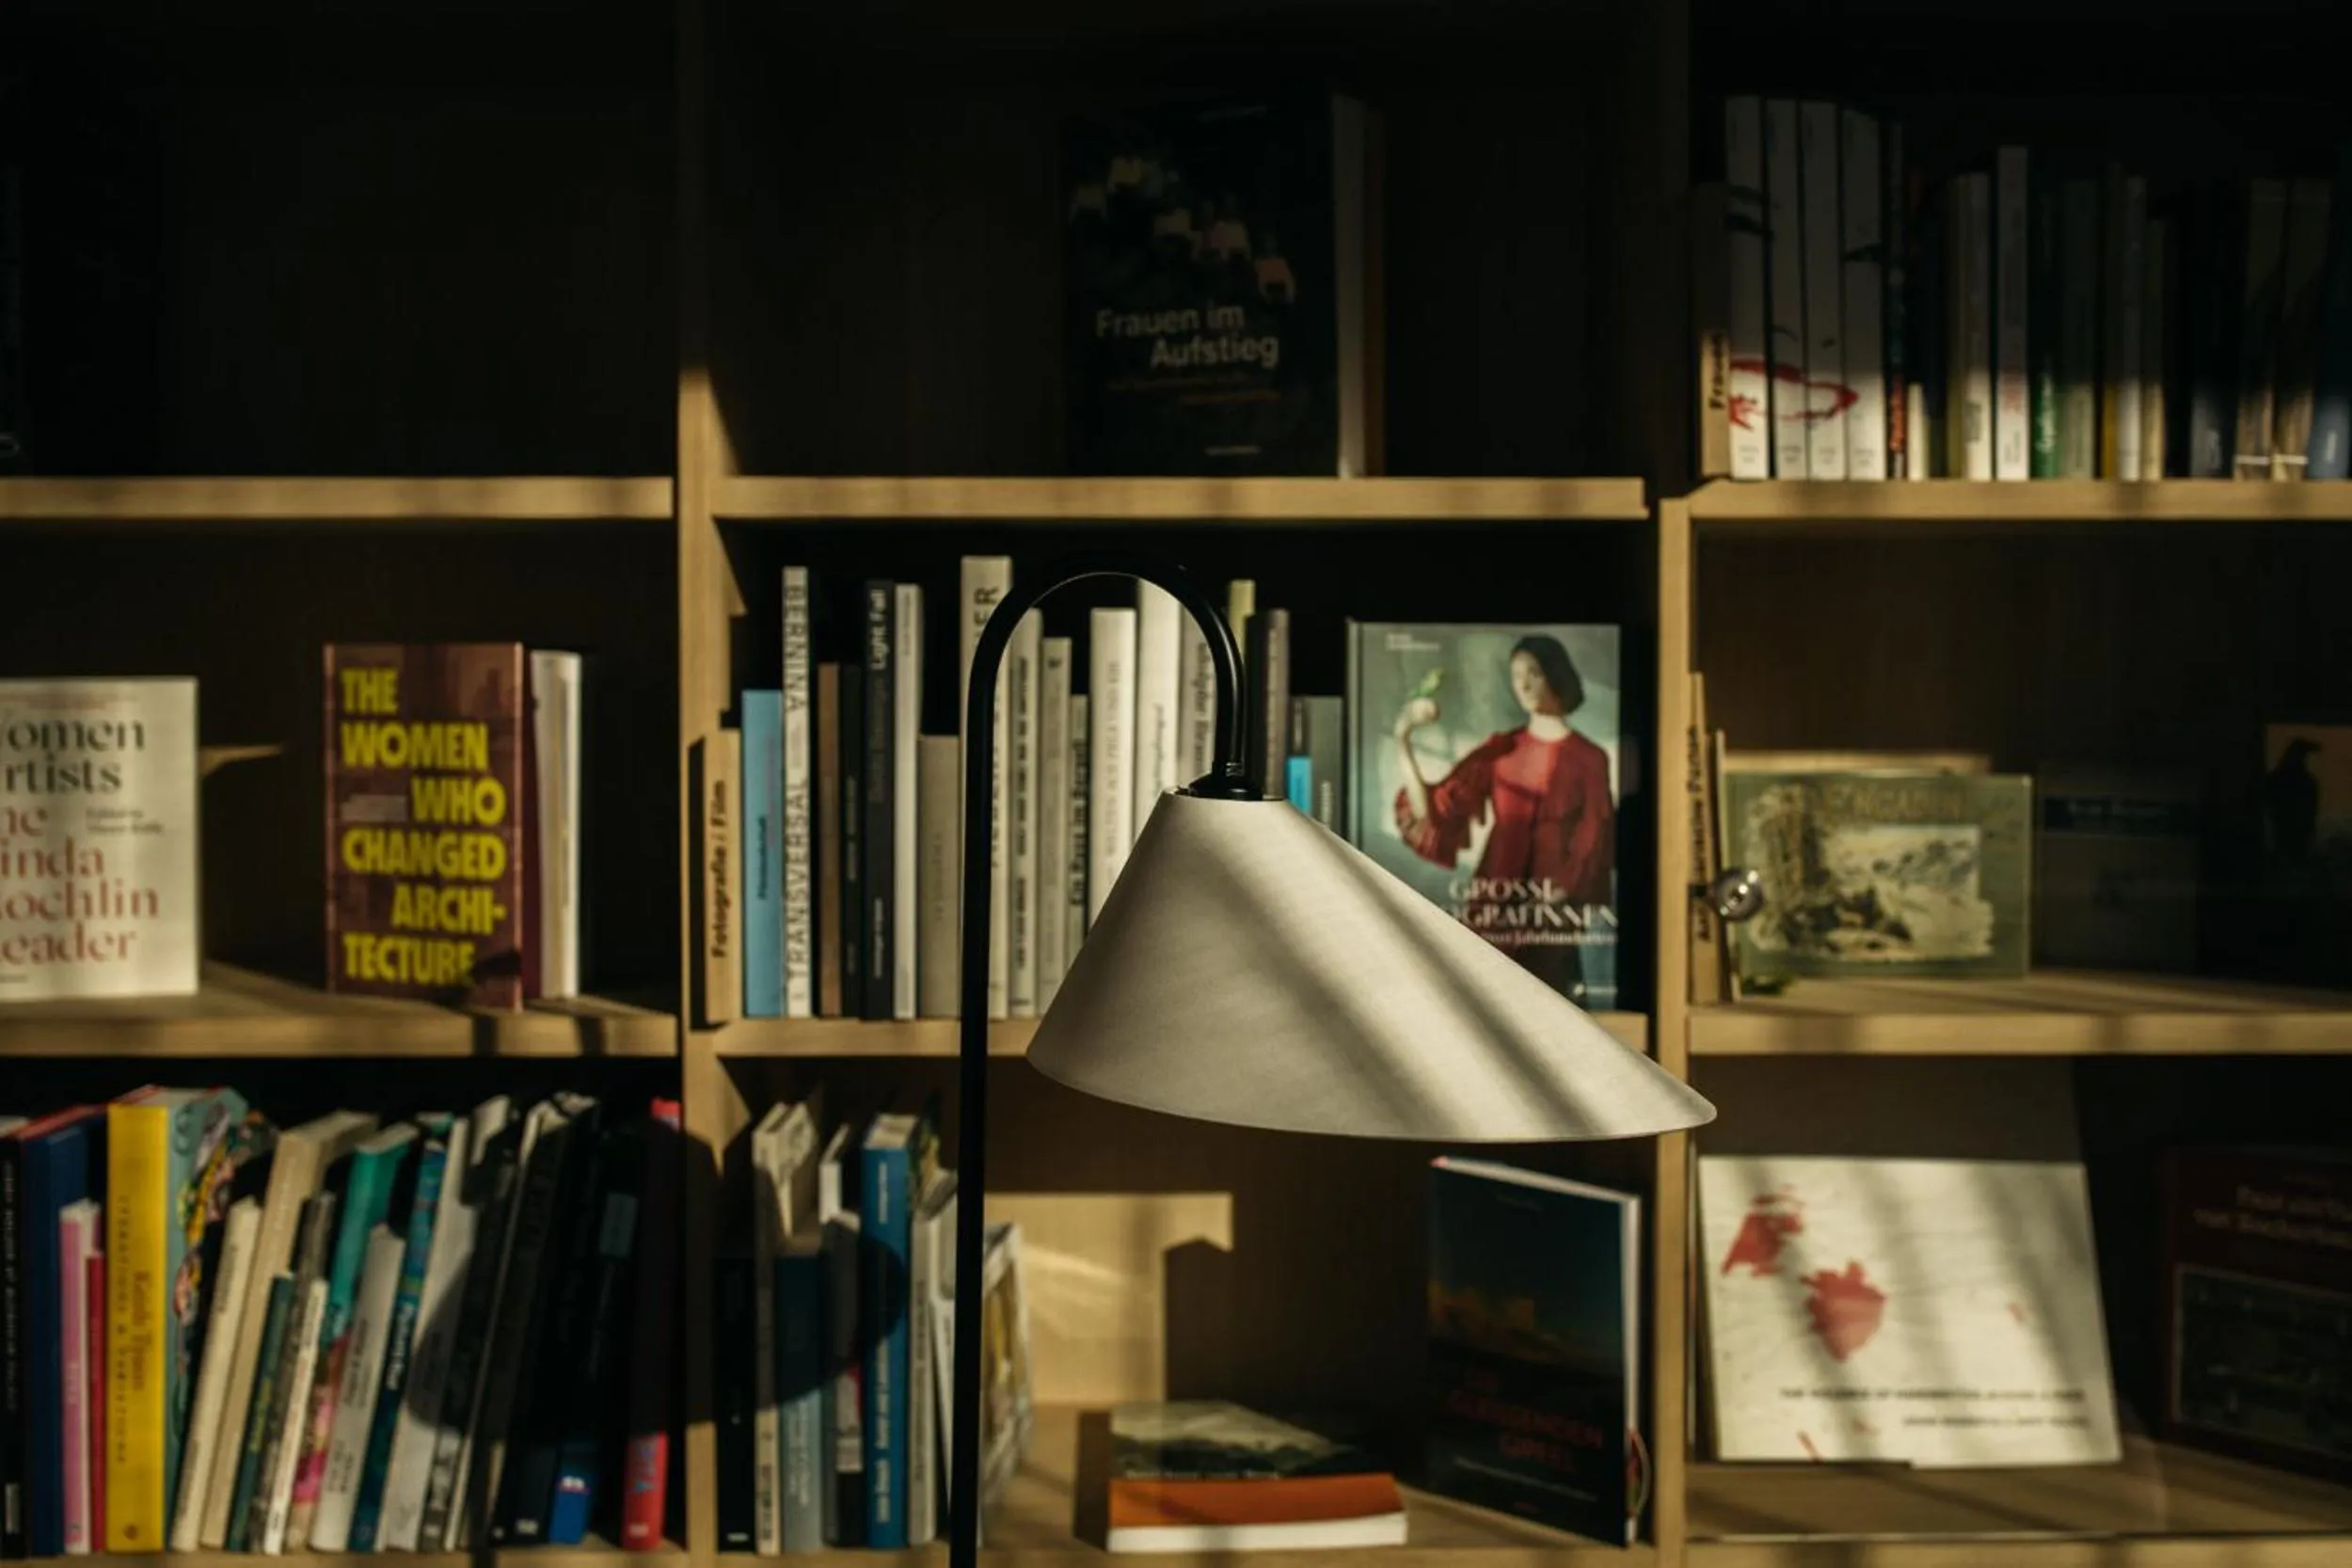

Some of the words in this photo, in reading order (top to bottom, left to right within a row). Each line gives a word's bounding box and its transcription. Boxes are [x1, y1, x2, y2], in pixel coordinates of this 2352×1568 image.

[1095, 308, 1200, 338] Frauen
[1150, 334, 1279, 369] Aufstieg
[341, 667, 399, 714] THE
[8, 721, 145, 752] omen
[341, 721, 489, 771] WOMEN
[5, 753, 122, 795] rtists
[410, 777, 507, 827] WHO
[0, 835, 104, 879] inda
[341, 828, 507, 880] CHANGED
[0, 877, 159, 921] ochlin
[390, 882, 507, 935] ARCHI-
[2, 920, 137, 965] eader
